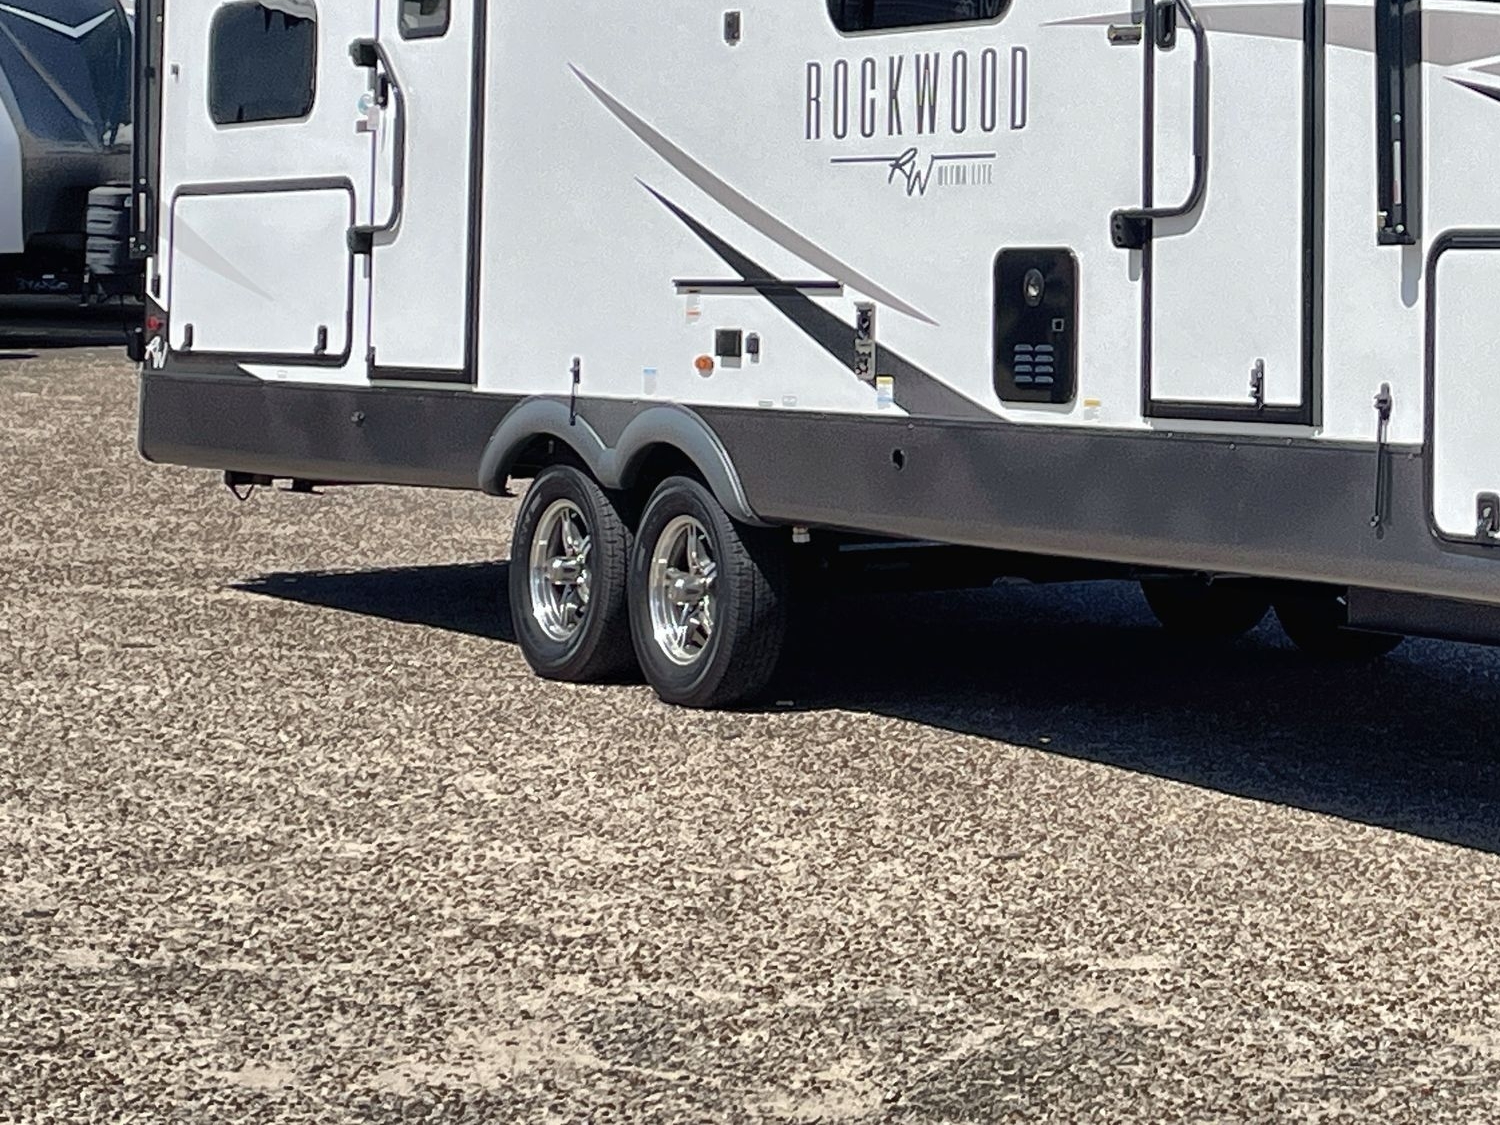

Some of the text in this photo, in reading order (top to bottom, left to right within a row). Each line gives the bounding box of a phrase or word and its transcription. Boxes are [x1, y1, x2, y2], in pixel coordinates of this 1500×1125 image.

[805, 46, 1029, 140] ROCKWOOD
[937, 165, 967, 187] ULTRA
[971, 163, 993, 186] LITE
